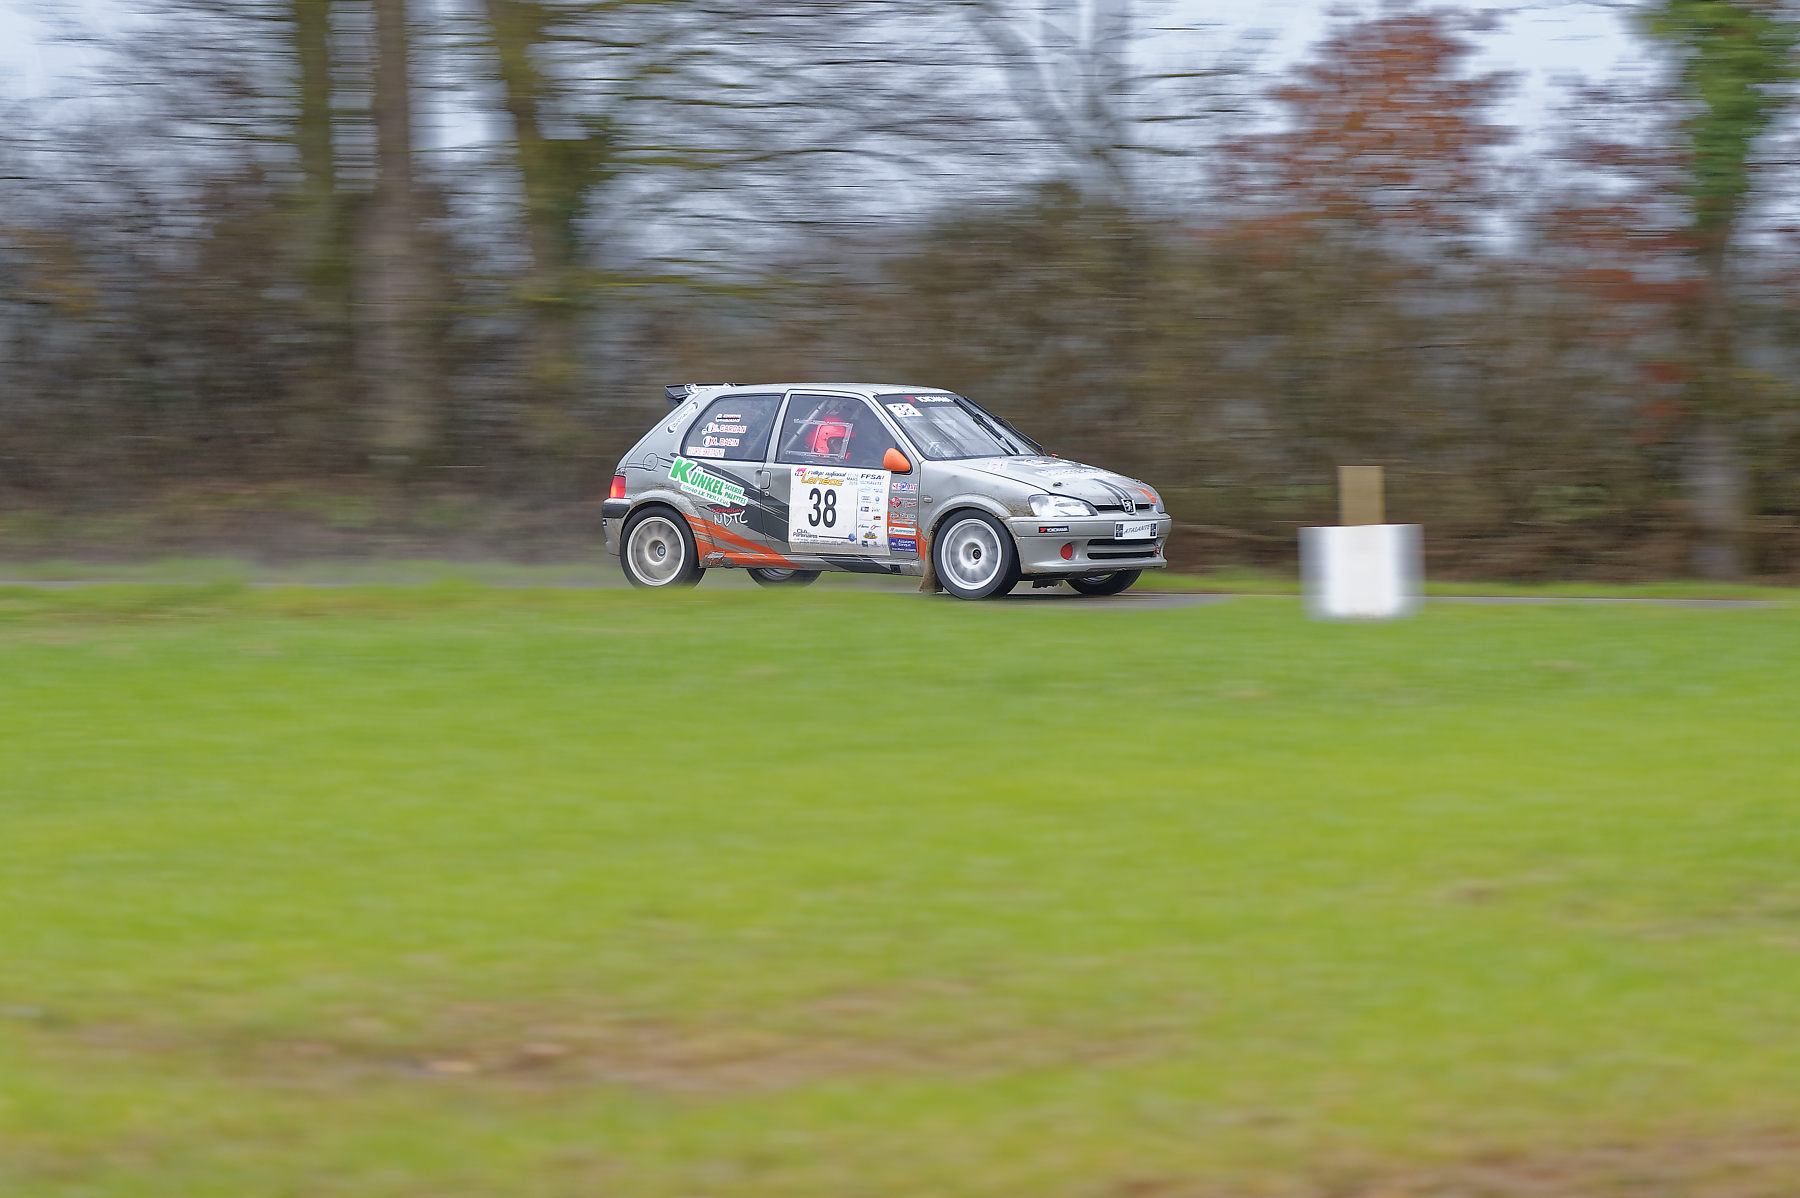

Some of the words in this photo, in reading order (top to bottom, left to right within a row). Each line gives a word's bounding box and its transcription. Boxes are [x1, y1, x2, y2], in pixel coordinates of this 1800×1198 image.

[670, 458, 725, 496] KÜNKEL
[724, 491, 747, 505] PALETTES
[808, 488, 837, 528] 38
[713, 510, 748, 527] NDTC
